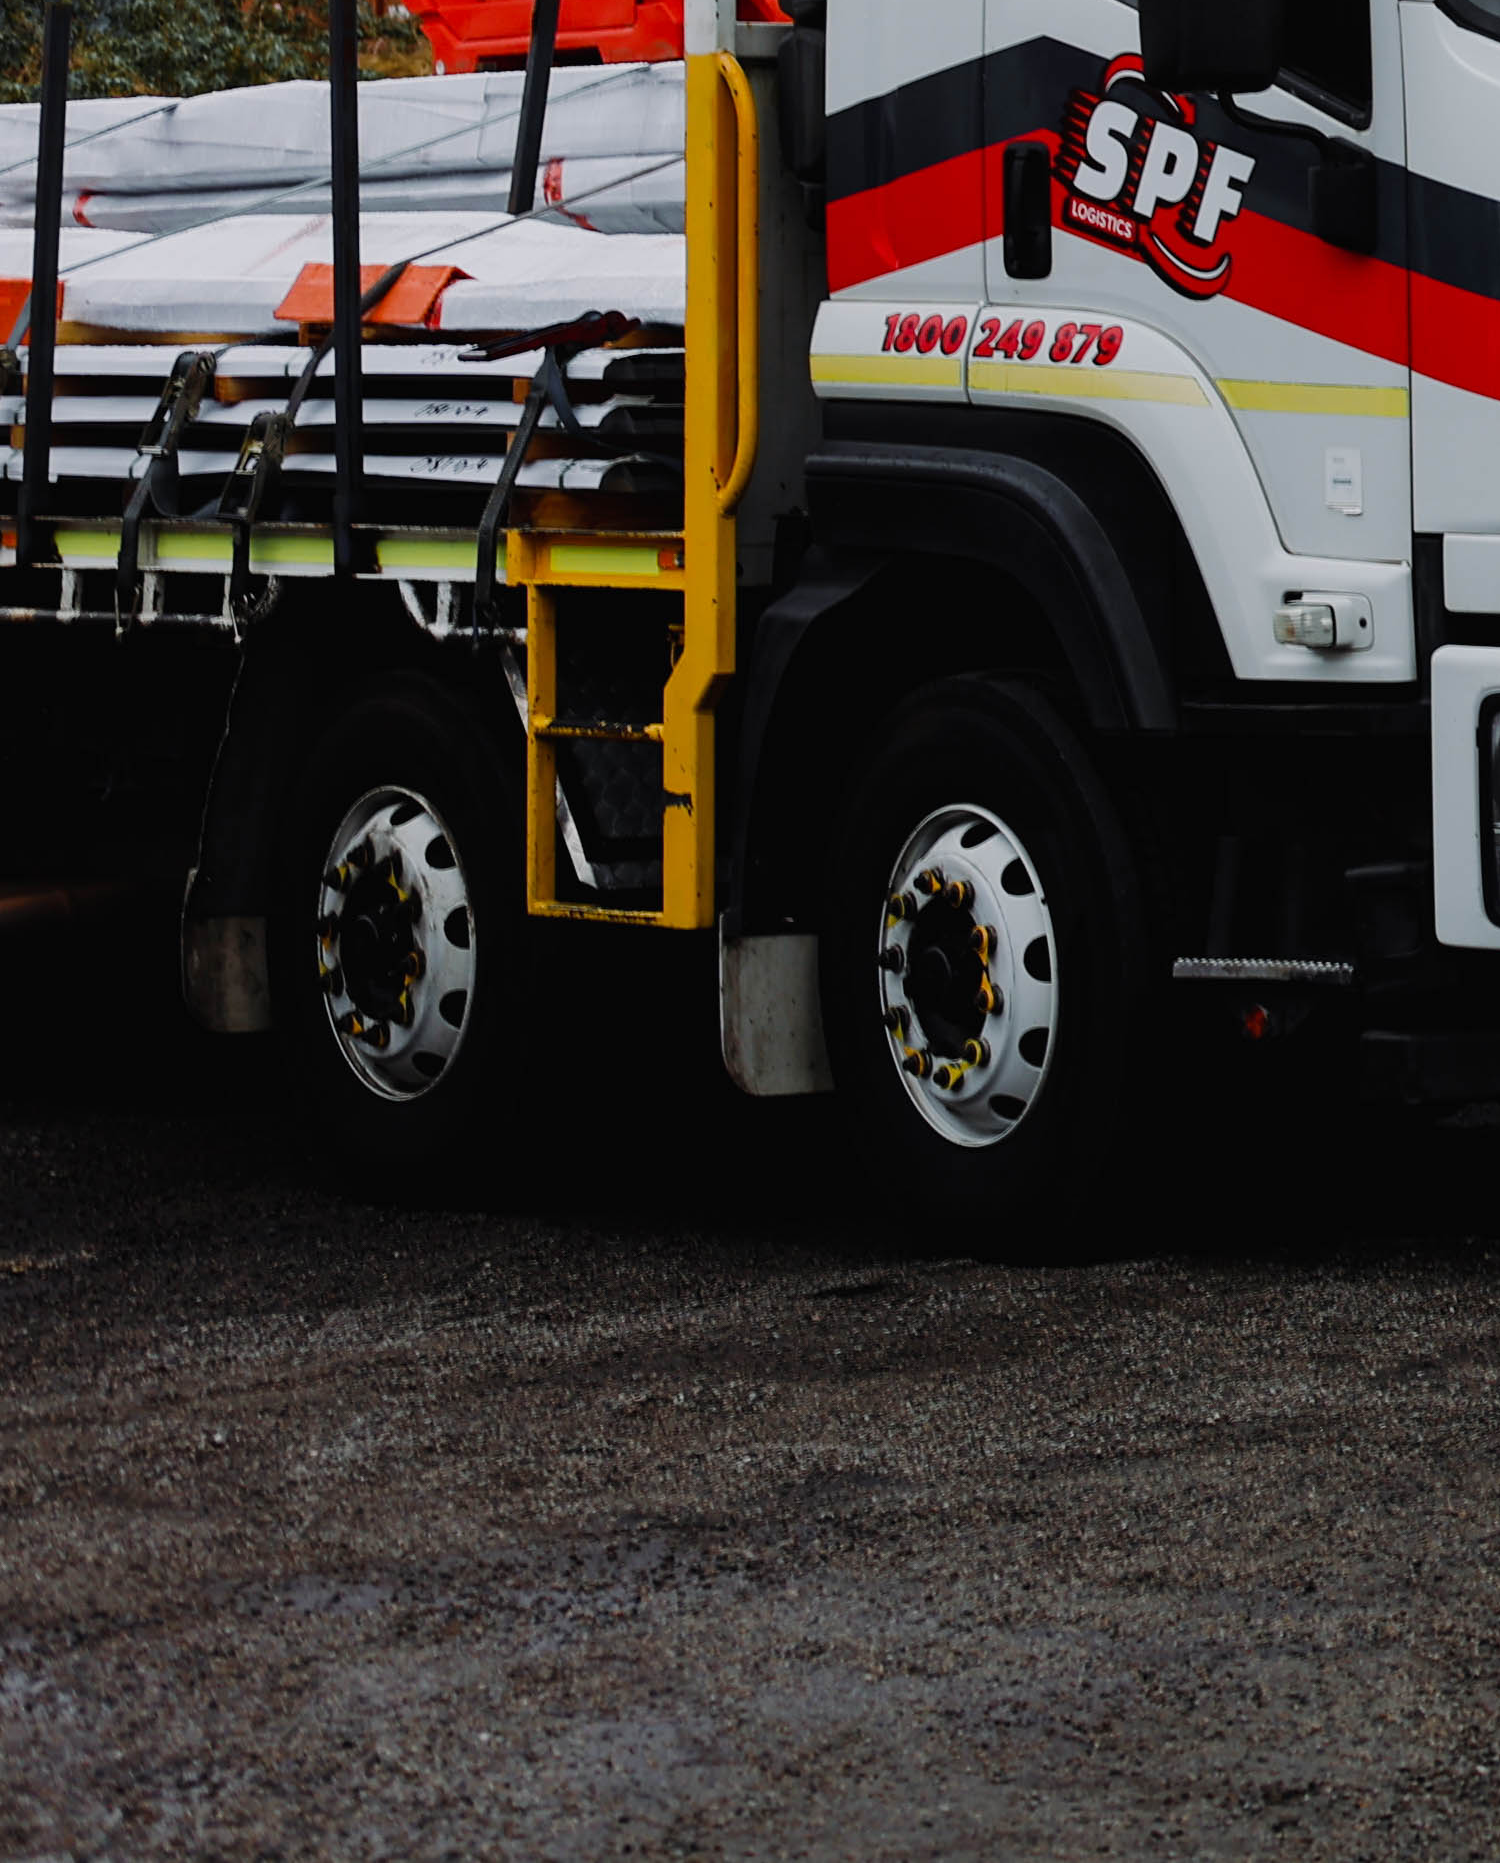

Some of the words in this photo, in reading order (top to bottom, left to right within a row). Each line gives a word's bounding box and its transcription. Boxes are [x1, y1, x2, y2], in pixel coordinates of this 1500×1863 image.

[1072, 100, 1256, 243] SPF
[1070, 199, 1134, 239] LOGISTICS
[883, 312, 967, 355] 1800
[973, 317, 1044, 361] 249
[1049, 324, 1123, 366] 879
